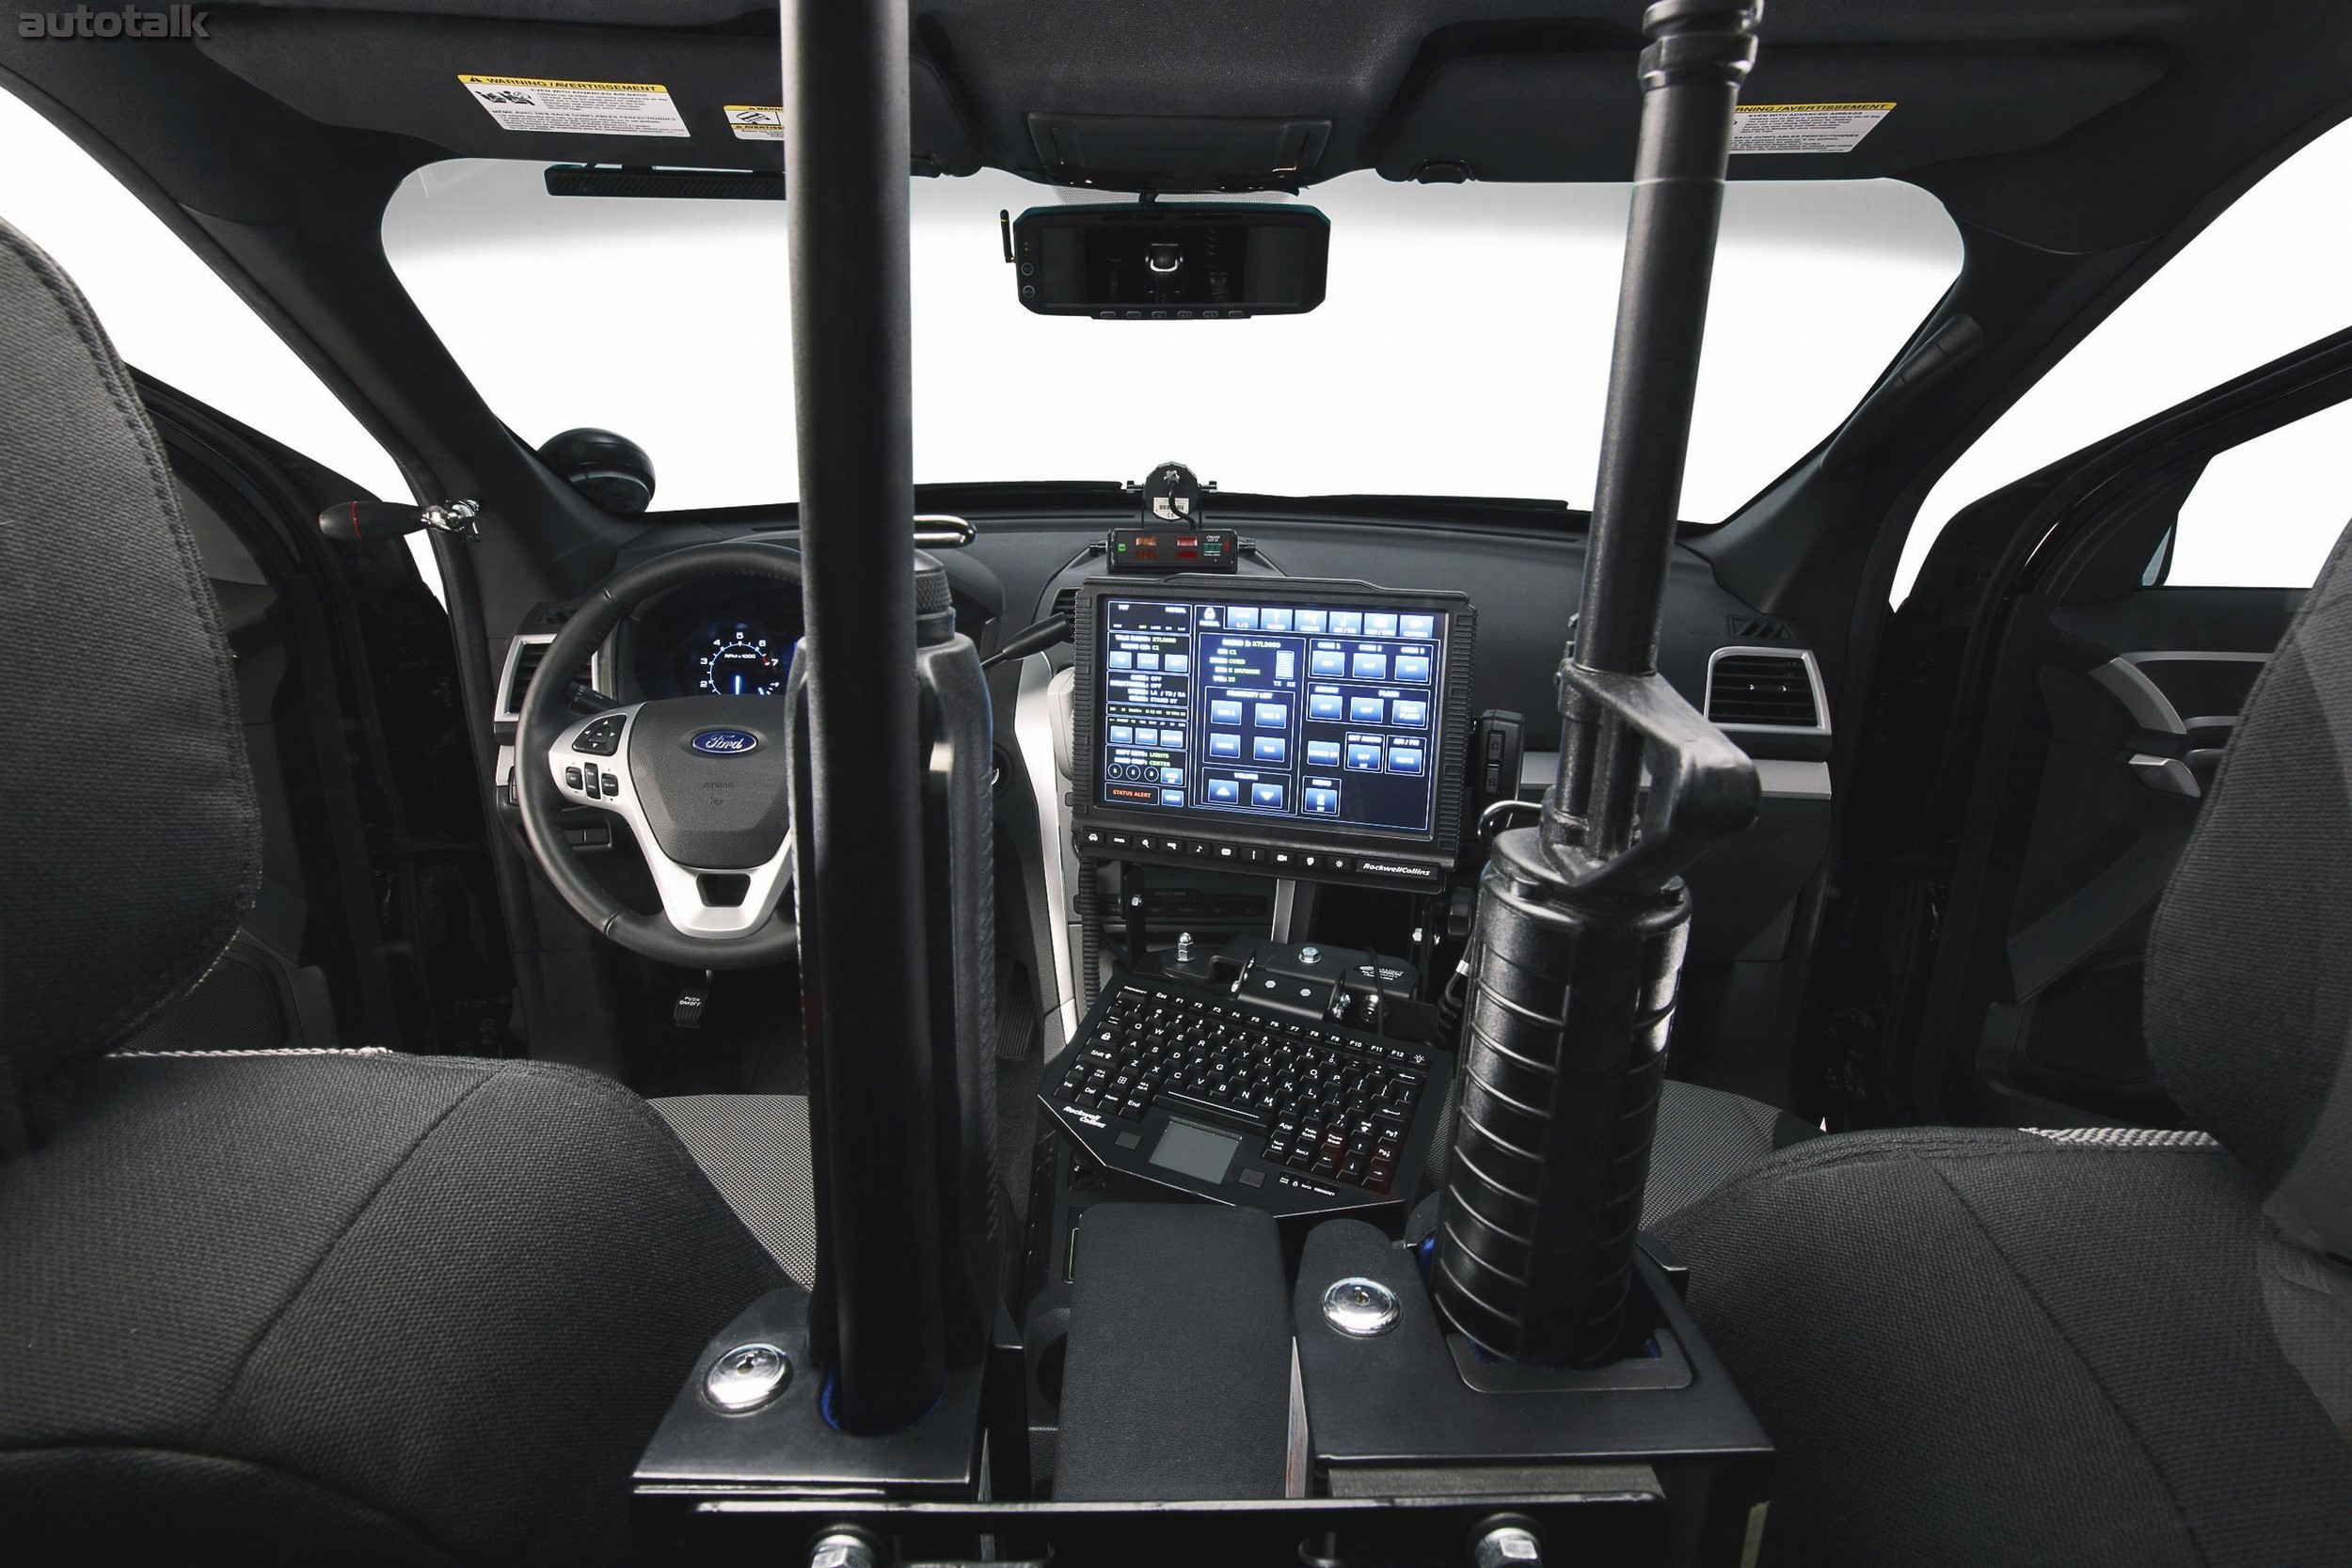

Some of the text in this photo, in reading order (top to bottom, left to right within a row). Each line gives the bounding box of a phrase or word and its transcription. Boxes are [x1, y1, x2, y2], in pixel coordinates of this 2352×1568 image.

[486, 77, 546, 87] WARNING
[771, 658, 779, 667] 7
[706, 734, 744, 749] Ford
[1362, 863, 1430, 876] RockwellCollins
[1155, 991, 1168, 1000] Esc
[1349, 1039, 1362, 1048] F10
[1090, 1050, 1104, 1058] Shift
[1241, 1090, 1250, 1100] N
[1127, 1100, 1141, 1108] End
[1063, 1105, 1102, 1119] Rockwell
[1079, 1115, 1107, 1129] Collins
[1279, 1122, 1293, 1131] App
